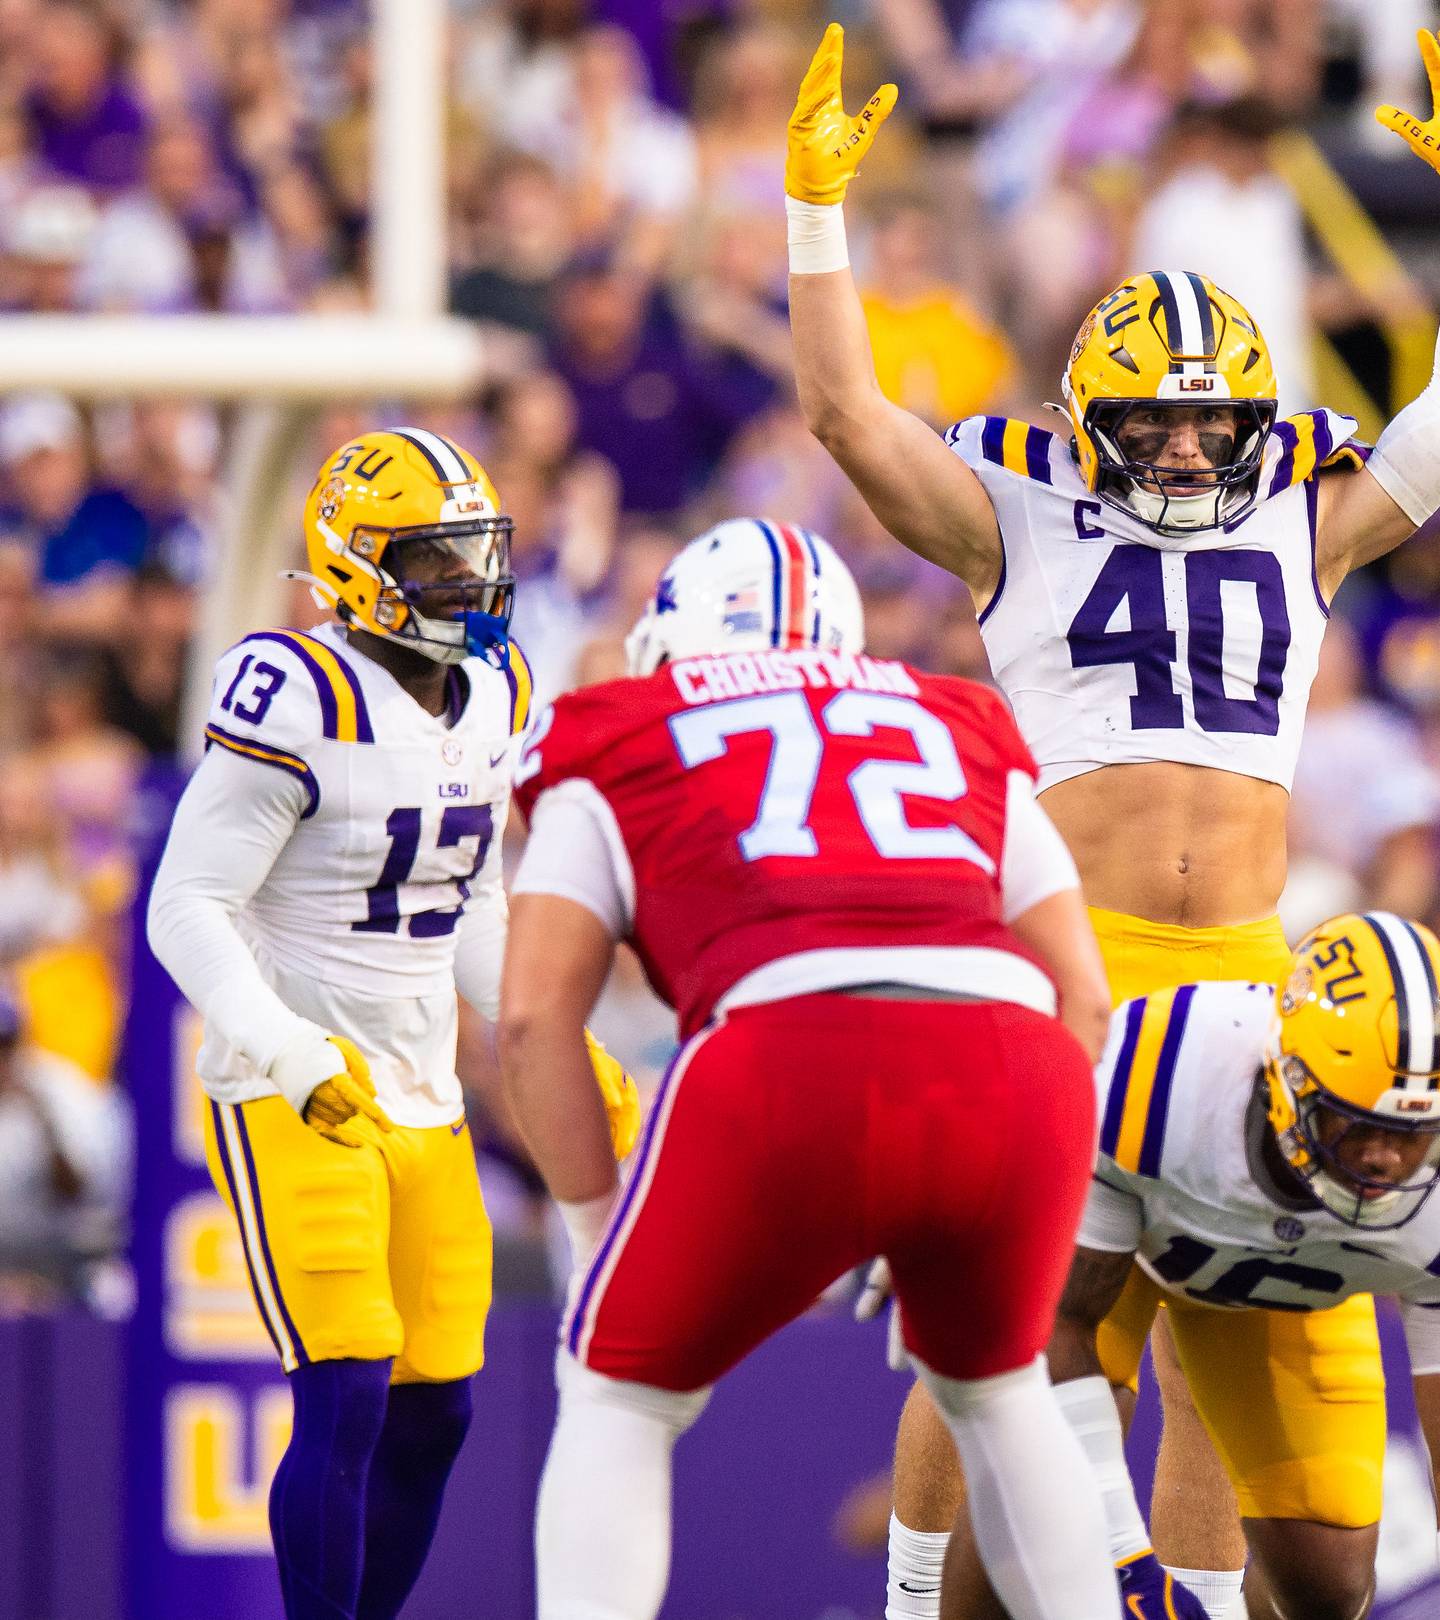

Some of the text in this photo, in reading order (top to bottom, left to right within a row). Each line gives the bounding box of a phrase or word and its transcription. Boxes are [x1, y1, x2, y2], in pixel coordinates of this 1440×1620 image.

[834, 96, 881, 157] TIGERS
[1178, 379, 1214, 392] LSU
[1073, 499, 1105, 540] C
[1066, 544, 1292, 736] 40
[219, 653, 287, 727] 13
[438, 782, 469, 798] LSU
[666, 689, 998, 863] 72
[350, 802, 494, 938] 13
